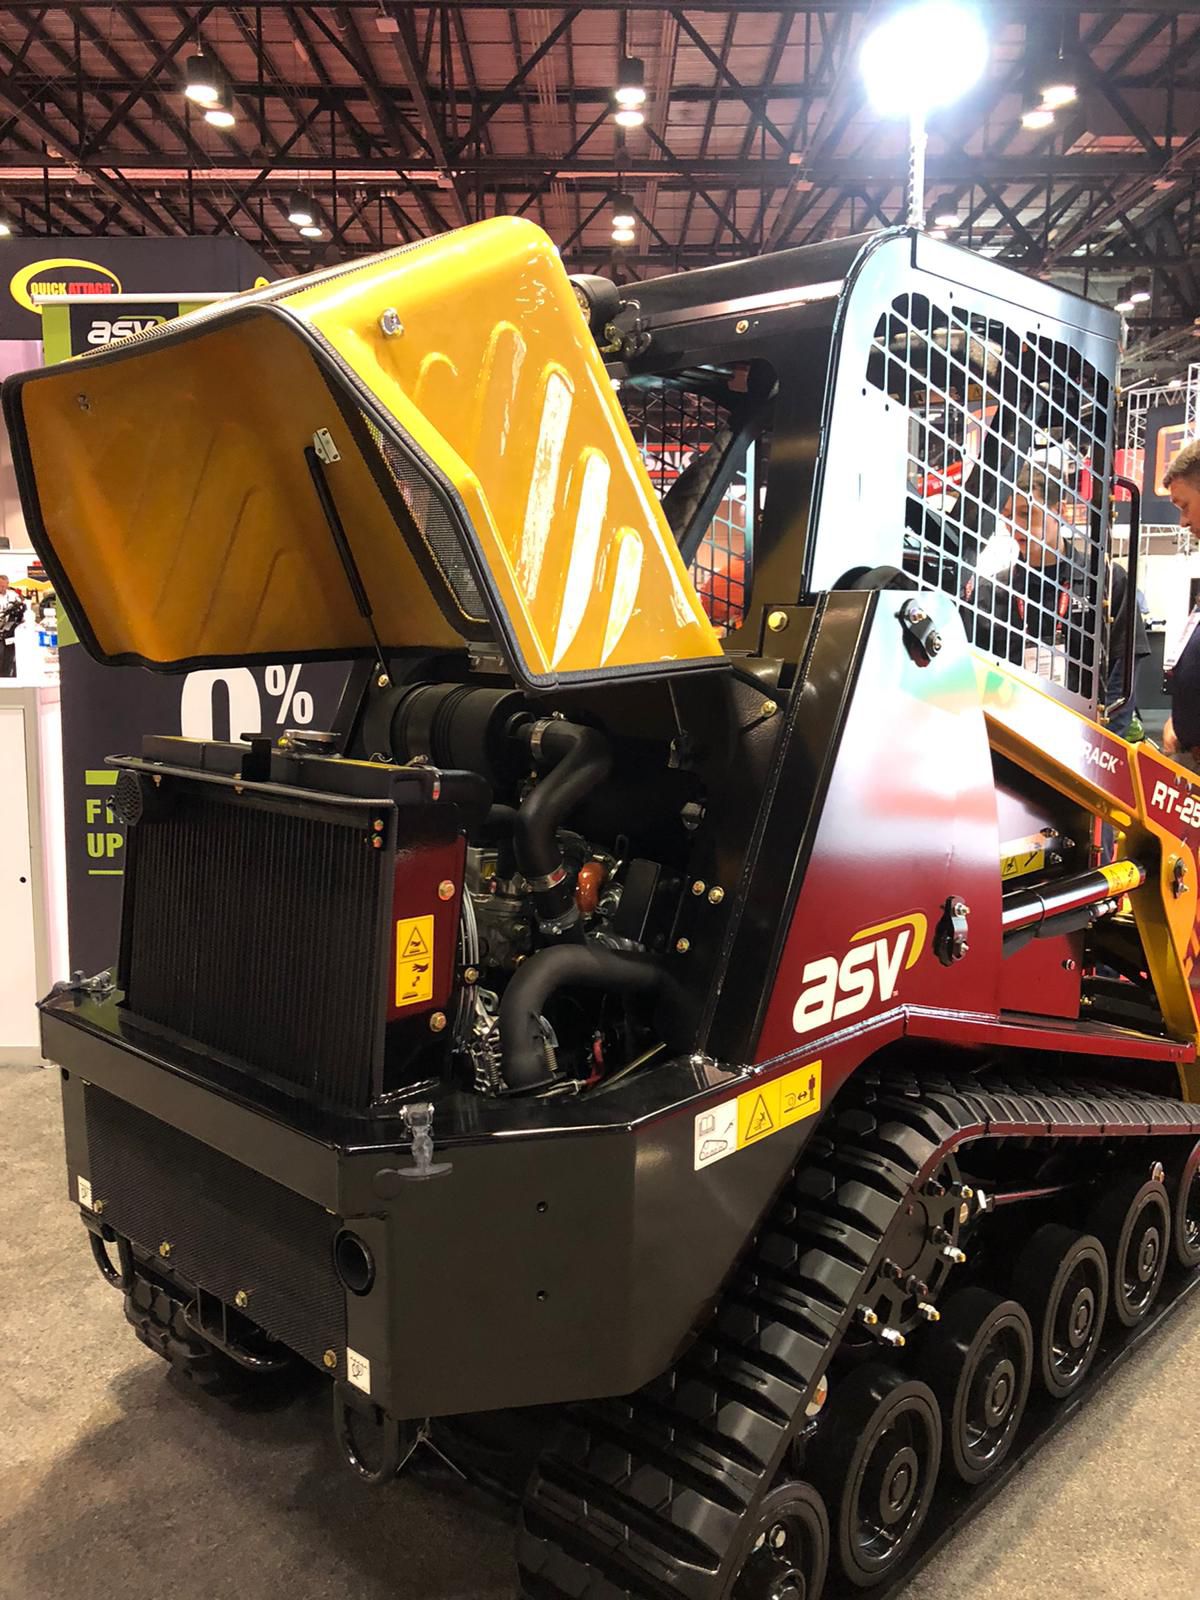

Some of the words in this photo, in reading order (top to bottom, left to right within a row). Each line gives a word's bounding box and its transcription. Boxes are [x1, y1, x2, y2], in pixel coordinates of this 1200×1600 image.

[31, 282, 67, 295] QUICK
[68, 282, 112, 295] ATTACH
[87, 833, 124, 858] UP
